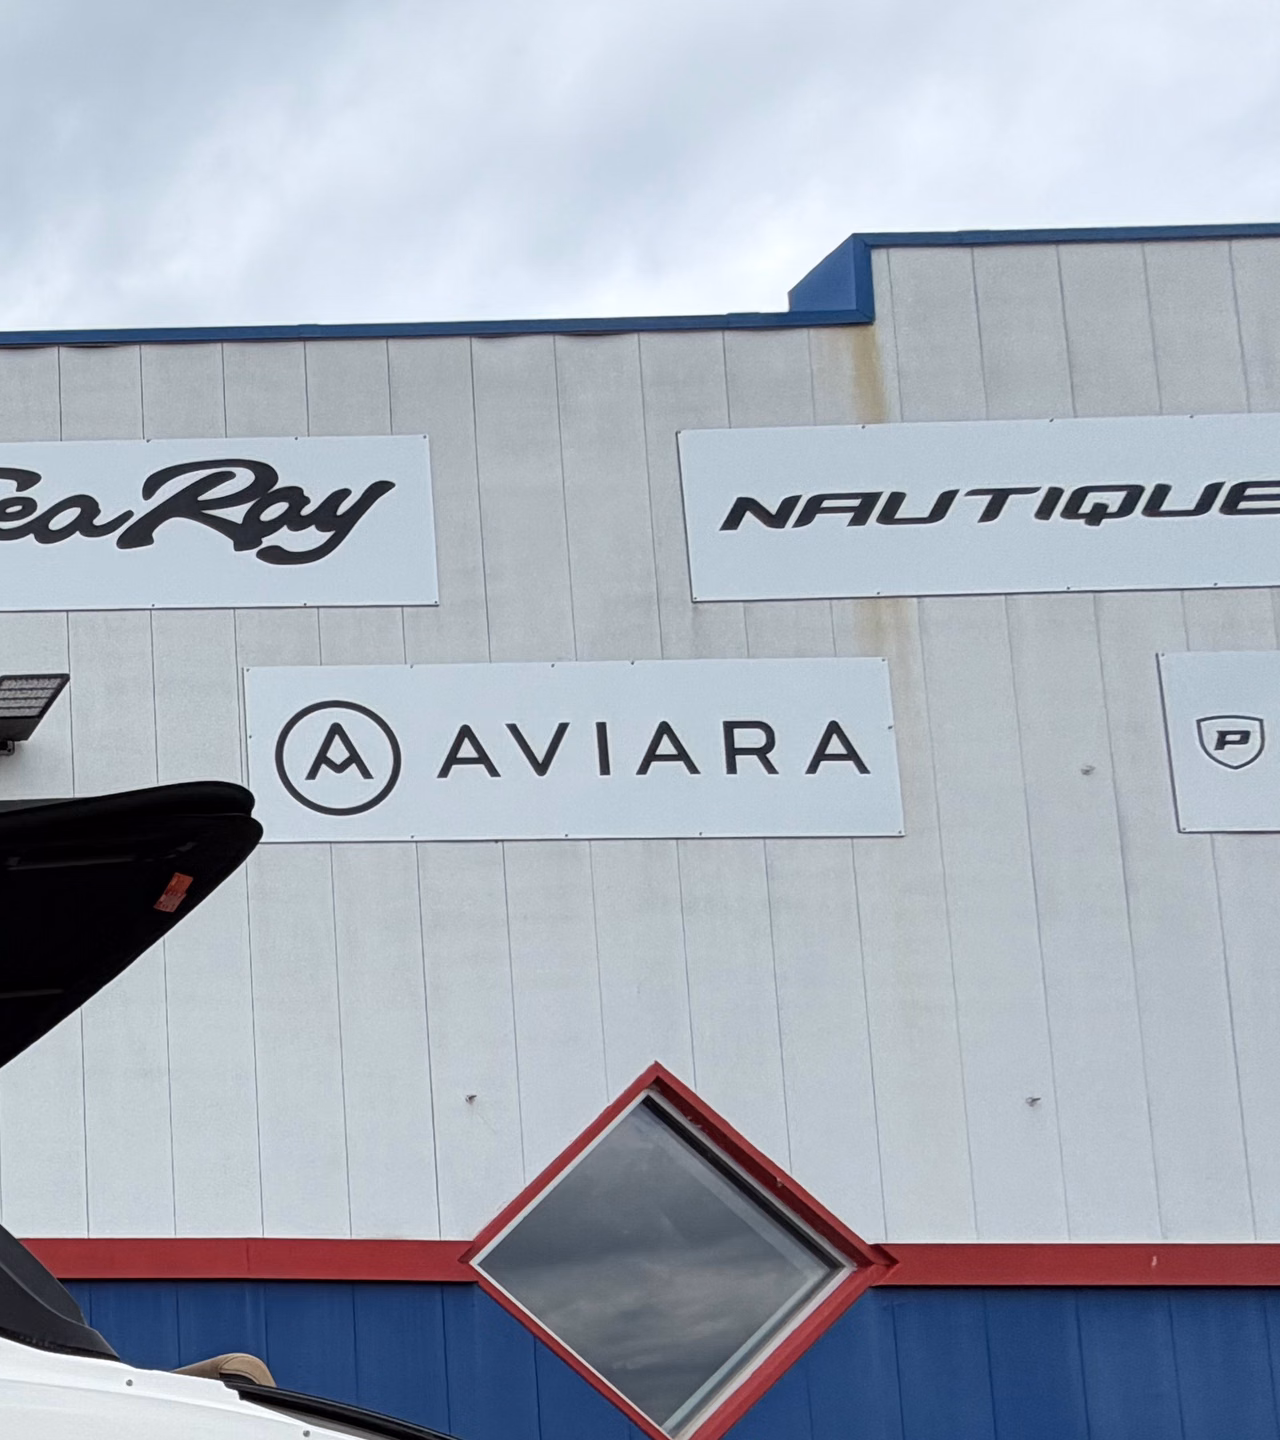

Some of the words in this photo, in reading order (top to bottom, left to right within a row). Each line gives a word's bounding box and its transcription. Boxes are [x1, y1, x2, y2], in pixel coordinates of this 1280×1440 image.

[116, 458, 396, 566] Ray
[719, 480, 1280, 531] NAUTIQUE
[437, 719, 871, 779] AVIARA
